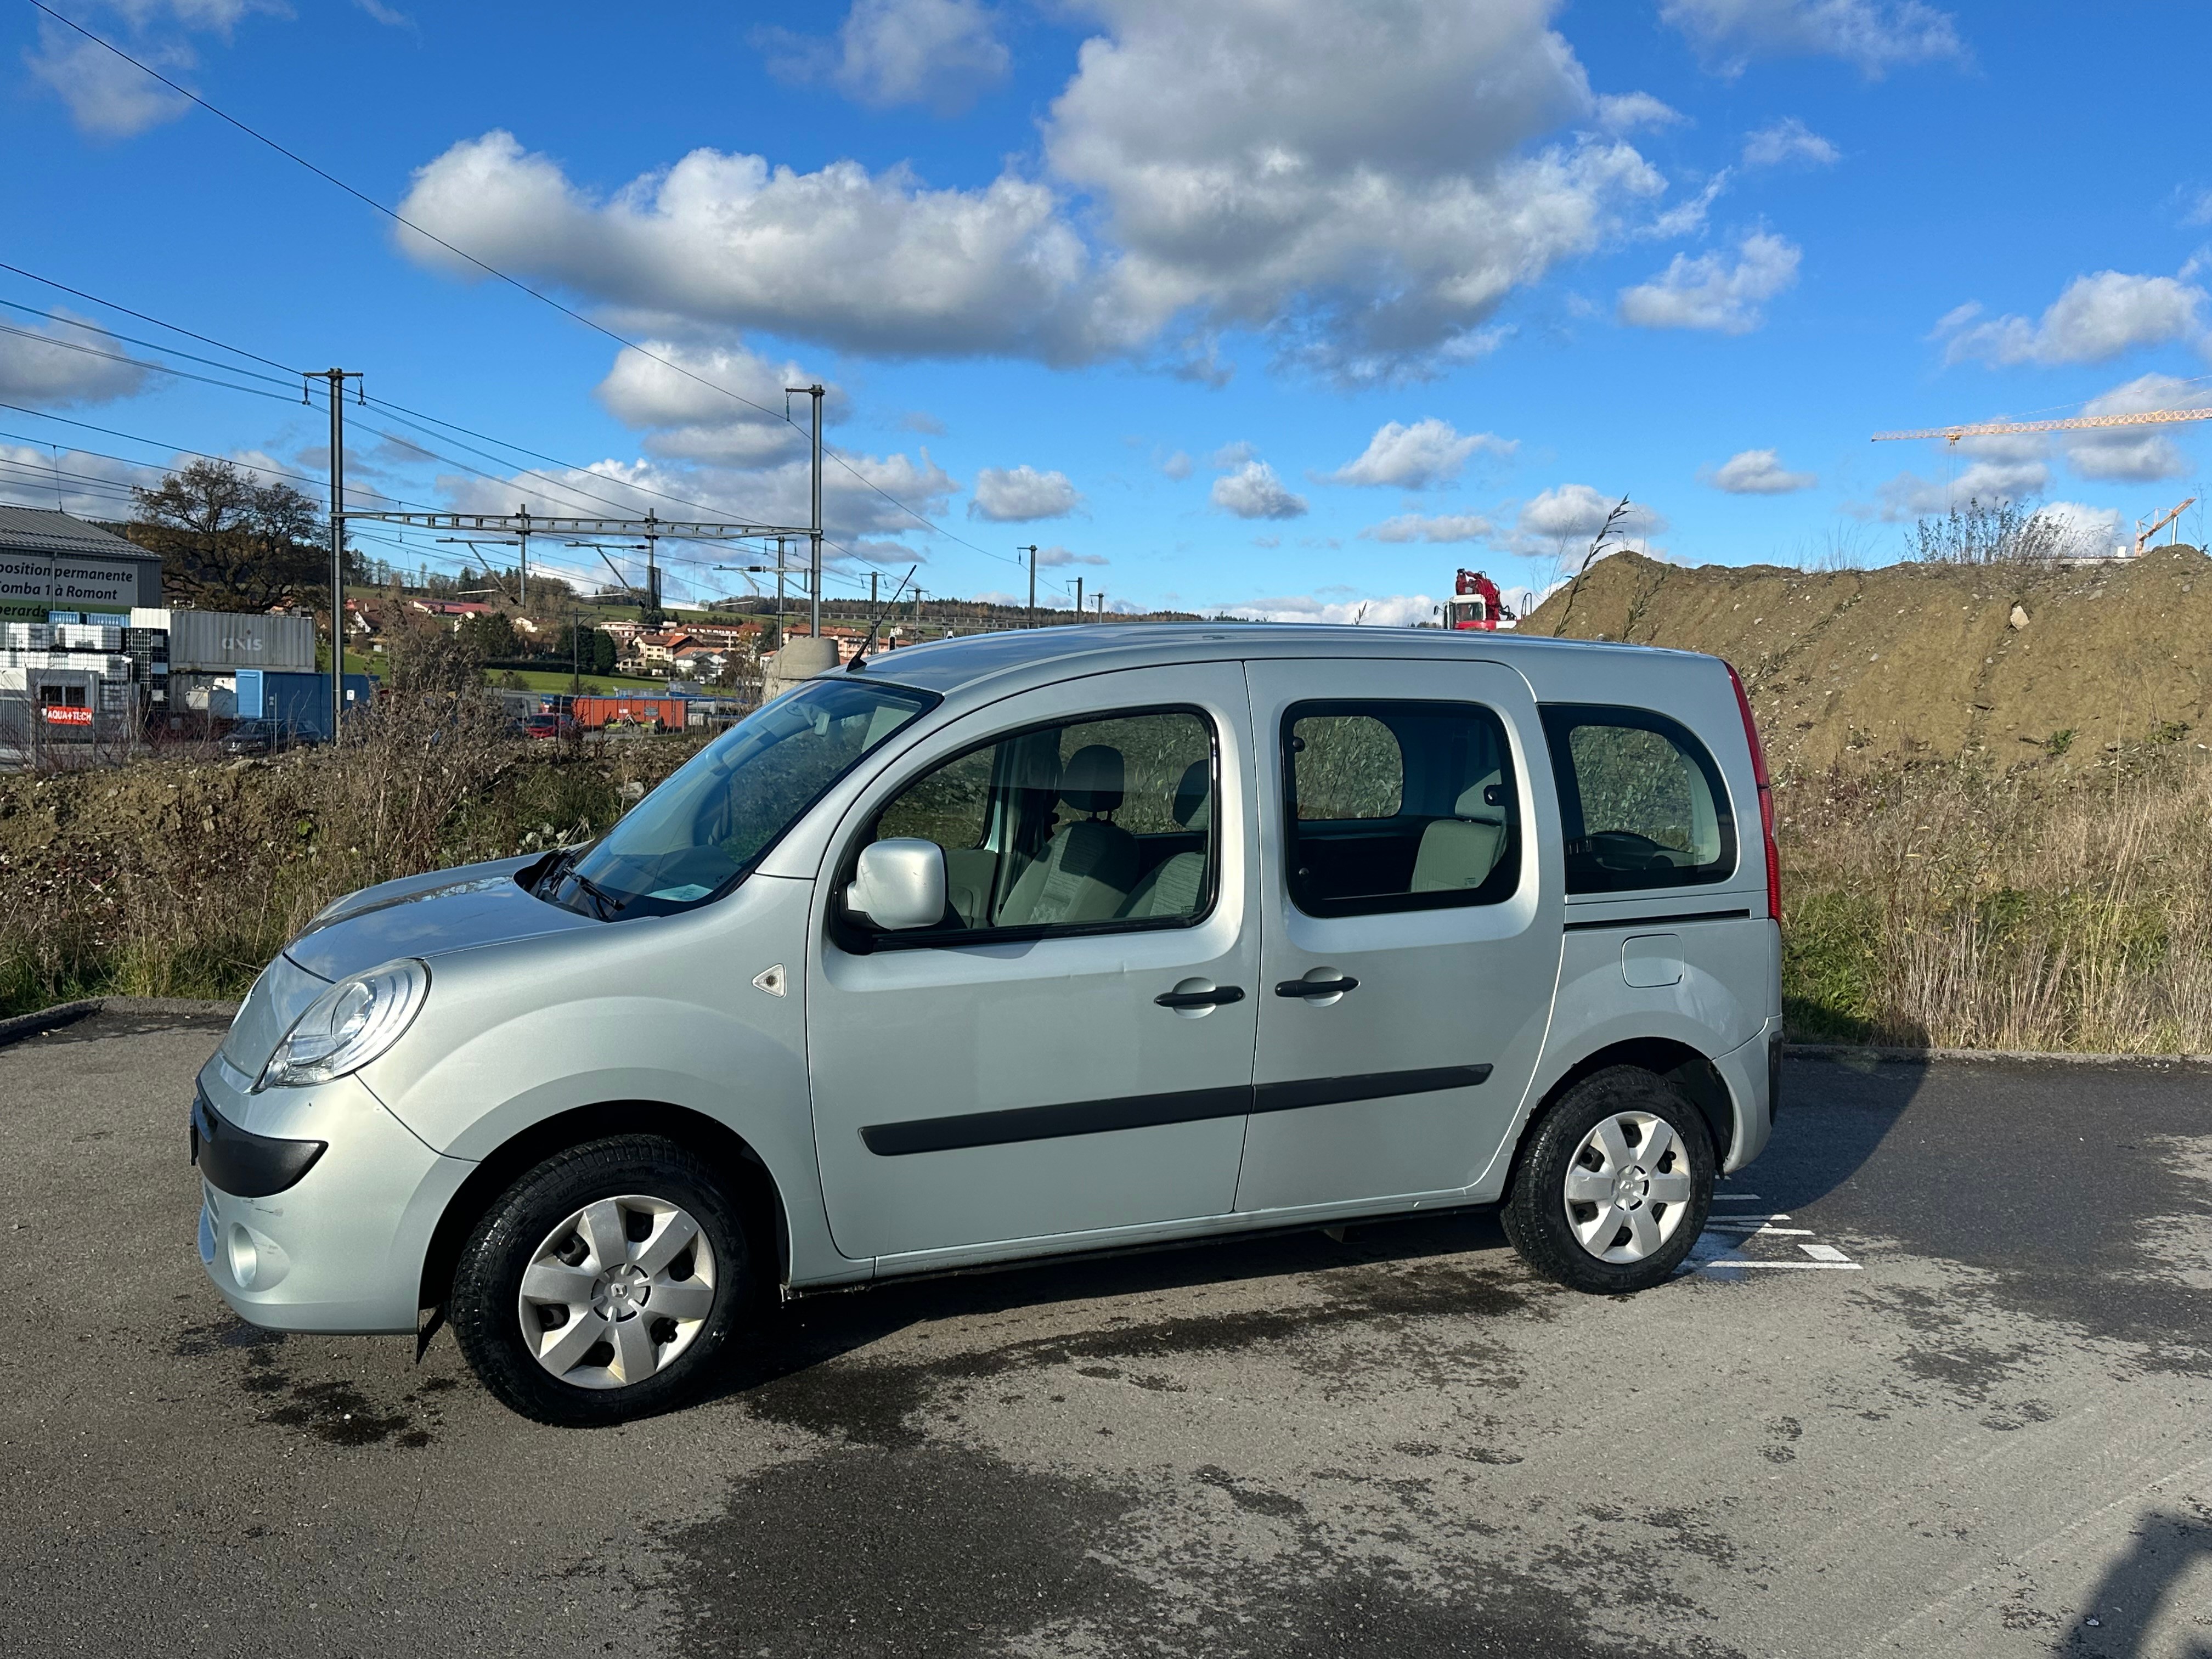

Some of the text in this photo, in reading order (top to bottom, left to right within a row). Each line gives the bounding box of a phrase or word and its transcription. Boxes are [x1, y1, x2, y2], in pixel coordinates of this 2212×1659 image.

[55, 567, 133, 582] permanente
[0, 580, 117, 600] omba 1 à Romont
